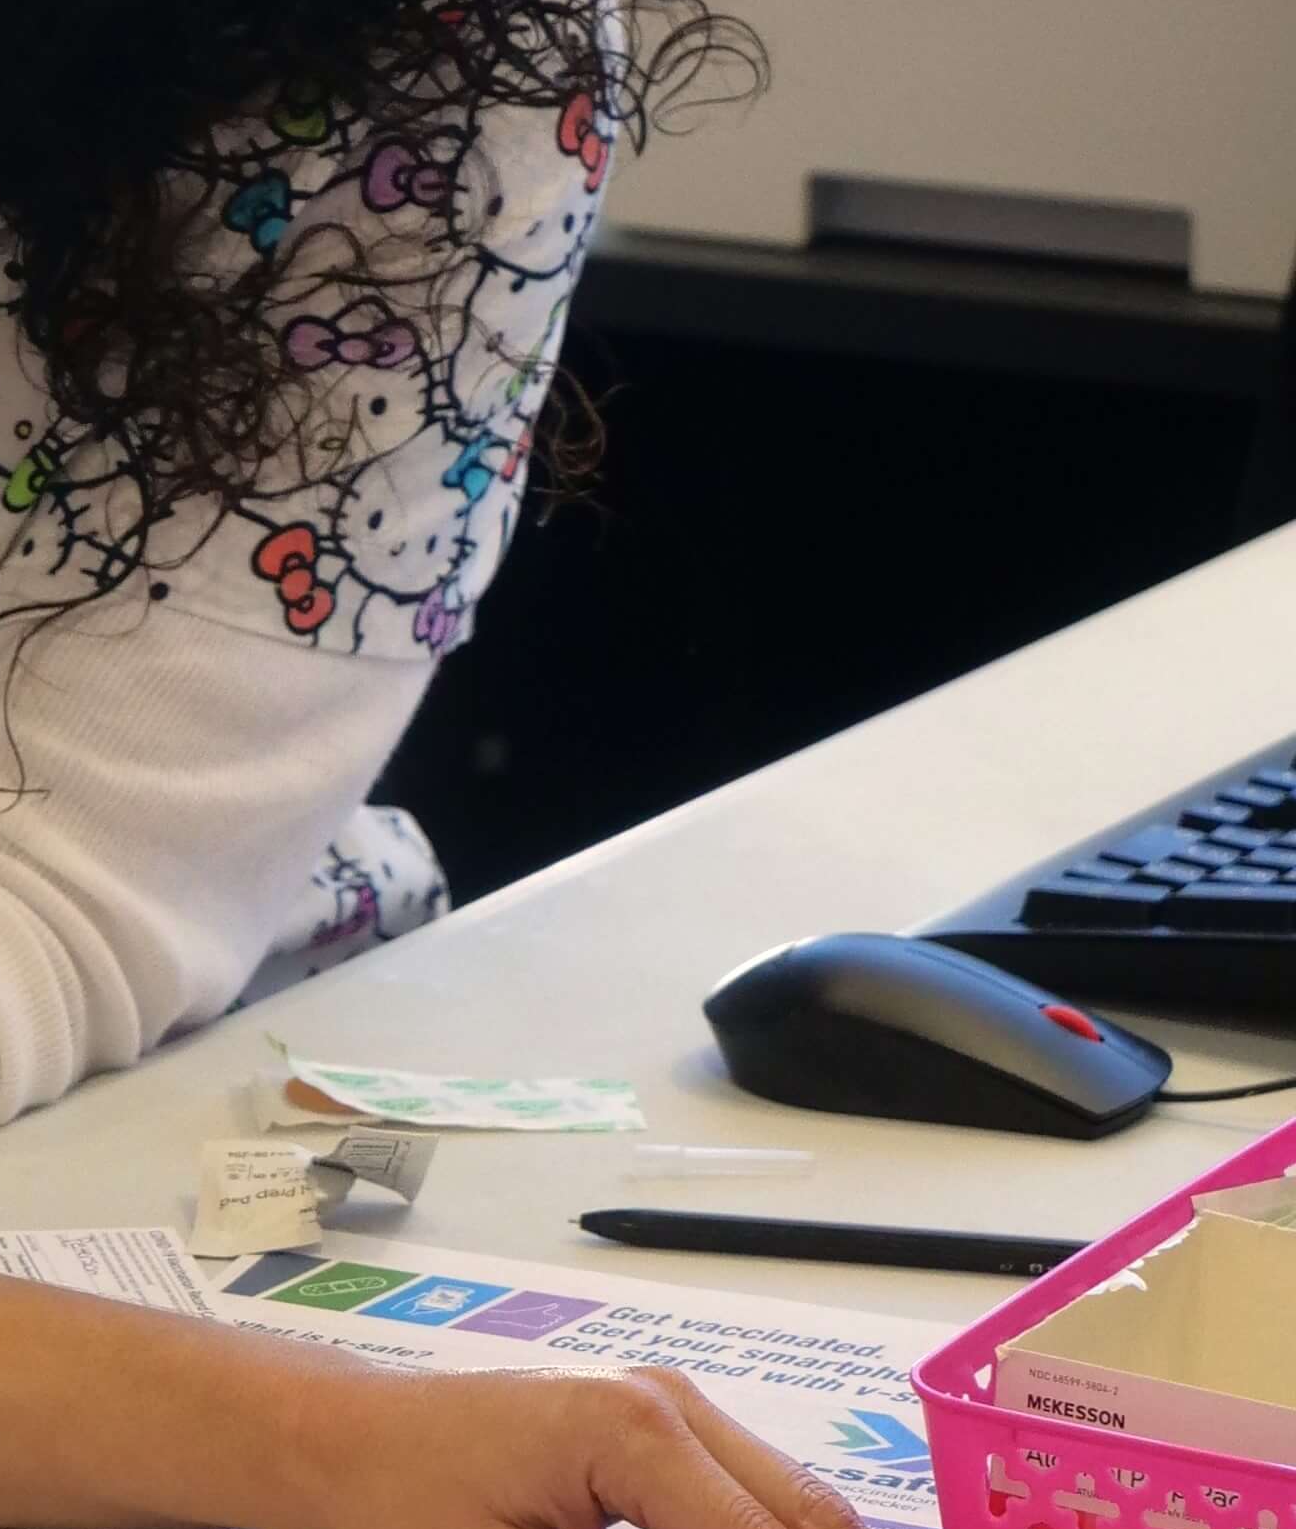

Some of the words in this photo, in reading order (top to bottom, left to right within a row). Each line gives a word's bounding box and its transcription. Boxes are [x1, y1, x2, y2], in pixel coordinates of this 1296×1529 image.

[219, 1195, 250, 1211] Pad
[255, 1185, 296, 1200] Prep
[296, 1330, 324, 1342] is
[330, 1337, 434, 1360] v-safe?
[606, 1305, 673, 1327] Get
[679, 1318, 885, 1360] vaccinated.
[575, 1320, 643, 1343] Get
[644, 1333, 734, 1357] your
[739, 1346, 911, 1383] smartpho
[546, 1334, 614, 1356] Get
[616, 1346, 756, 1379] started
[759, 1370, 845, 1393] with
[855, 1385, 920, 1405] v-s
[1028, 1368, 1051, 1382] NDC
[800, 1461, 937, 1496] -saf
[835, 1483, 937, 1506] accination
